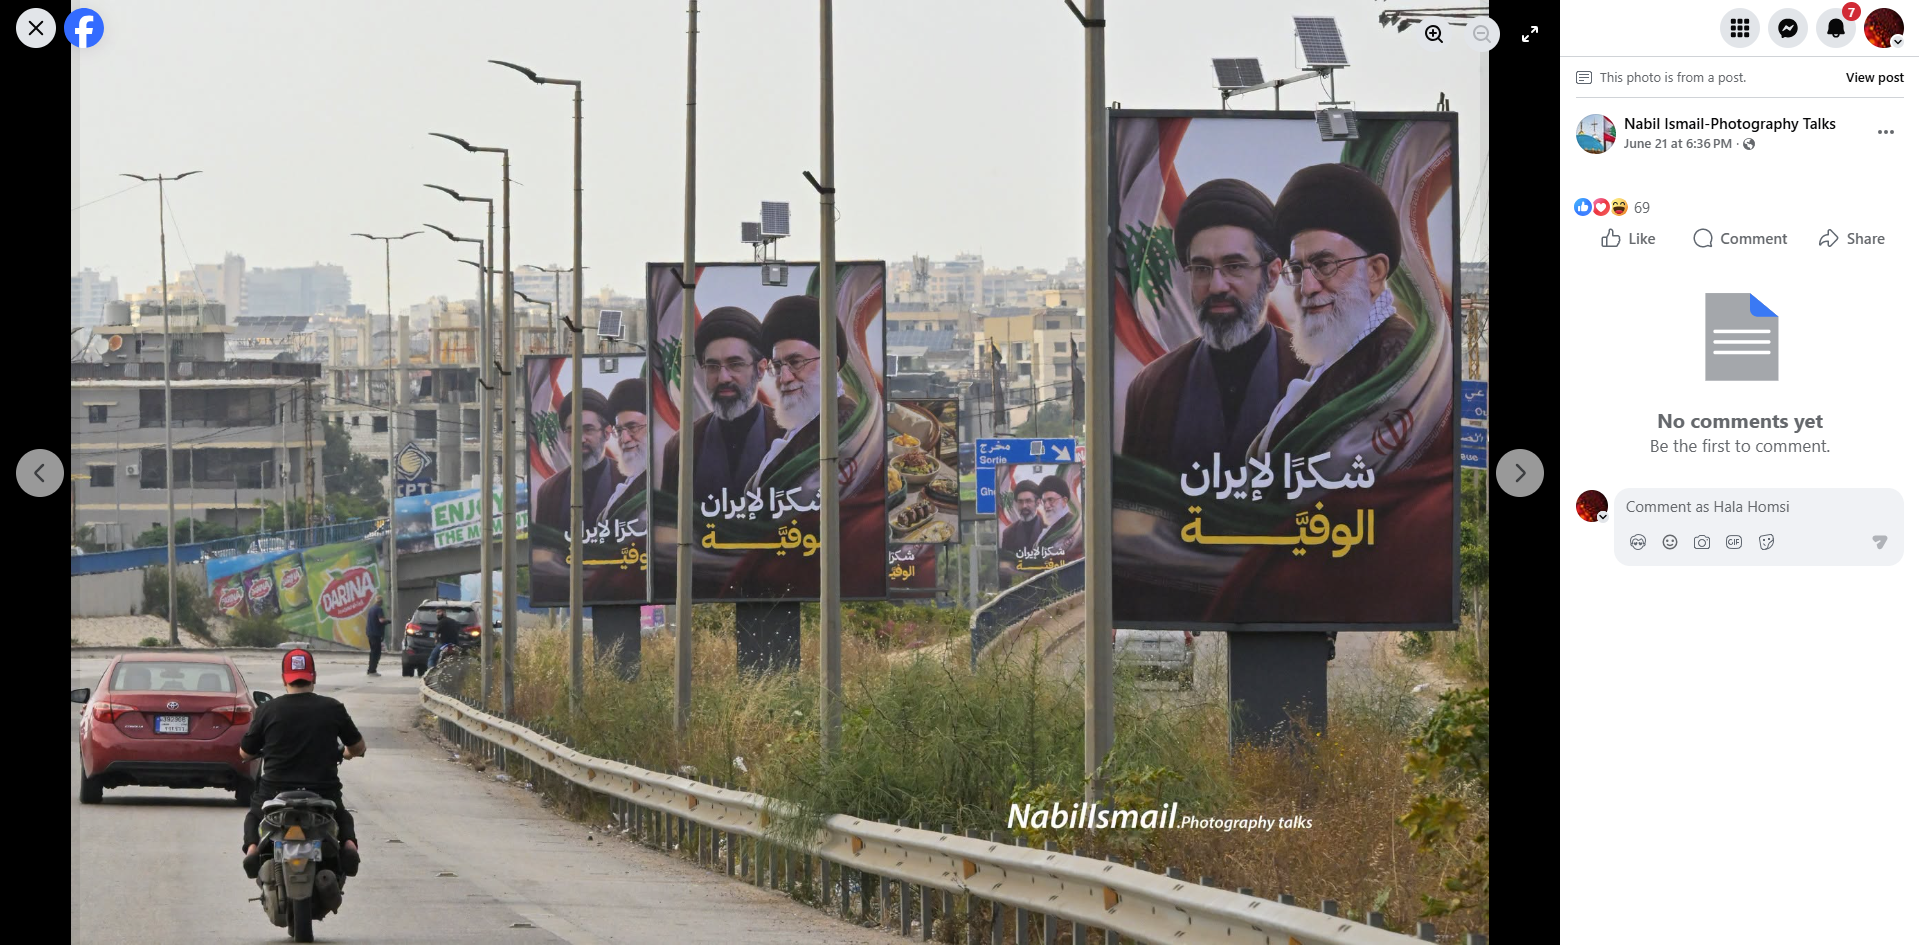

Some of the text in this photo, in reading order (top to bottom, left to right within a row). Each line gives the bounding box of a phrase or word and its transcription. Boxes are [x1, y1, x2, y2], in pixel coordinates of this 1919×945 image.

[1848, 7, 1856, 17] 7
[1600, 72, 1747, 86] This photo is from a post.
[1845, 72, 1905, 86] View post
[1624, 118, 1837, 133] Nabil Ismail-Photography Talks
[1624, 139, 1732, 149] June 21 at 6:36 PM
[1634, 201, 1651, 214] 69
[1629, 232, 1656, 245] Like
[1720, 232, 1788, 245] Comment
[1847, 232, 1886, 245] Share
[1658, 413, 1824, 434] No comments yet
[979, 440, 1011, 453] مخرج
[1650, 438, 1830, 453] Be the first to comment.
[979, 455, 1008, 464] Sortie
[1180, 451, 1375, 501] شكرًا لإيران
[700, 487, 764, 520] لإيران
[1625, 500, 1790, 513] Comment as Hala Homsi
[436, 528, 464, 546] THE
[322, 570, 375, 613] DARINA
